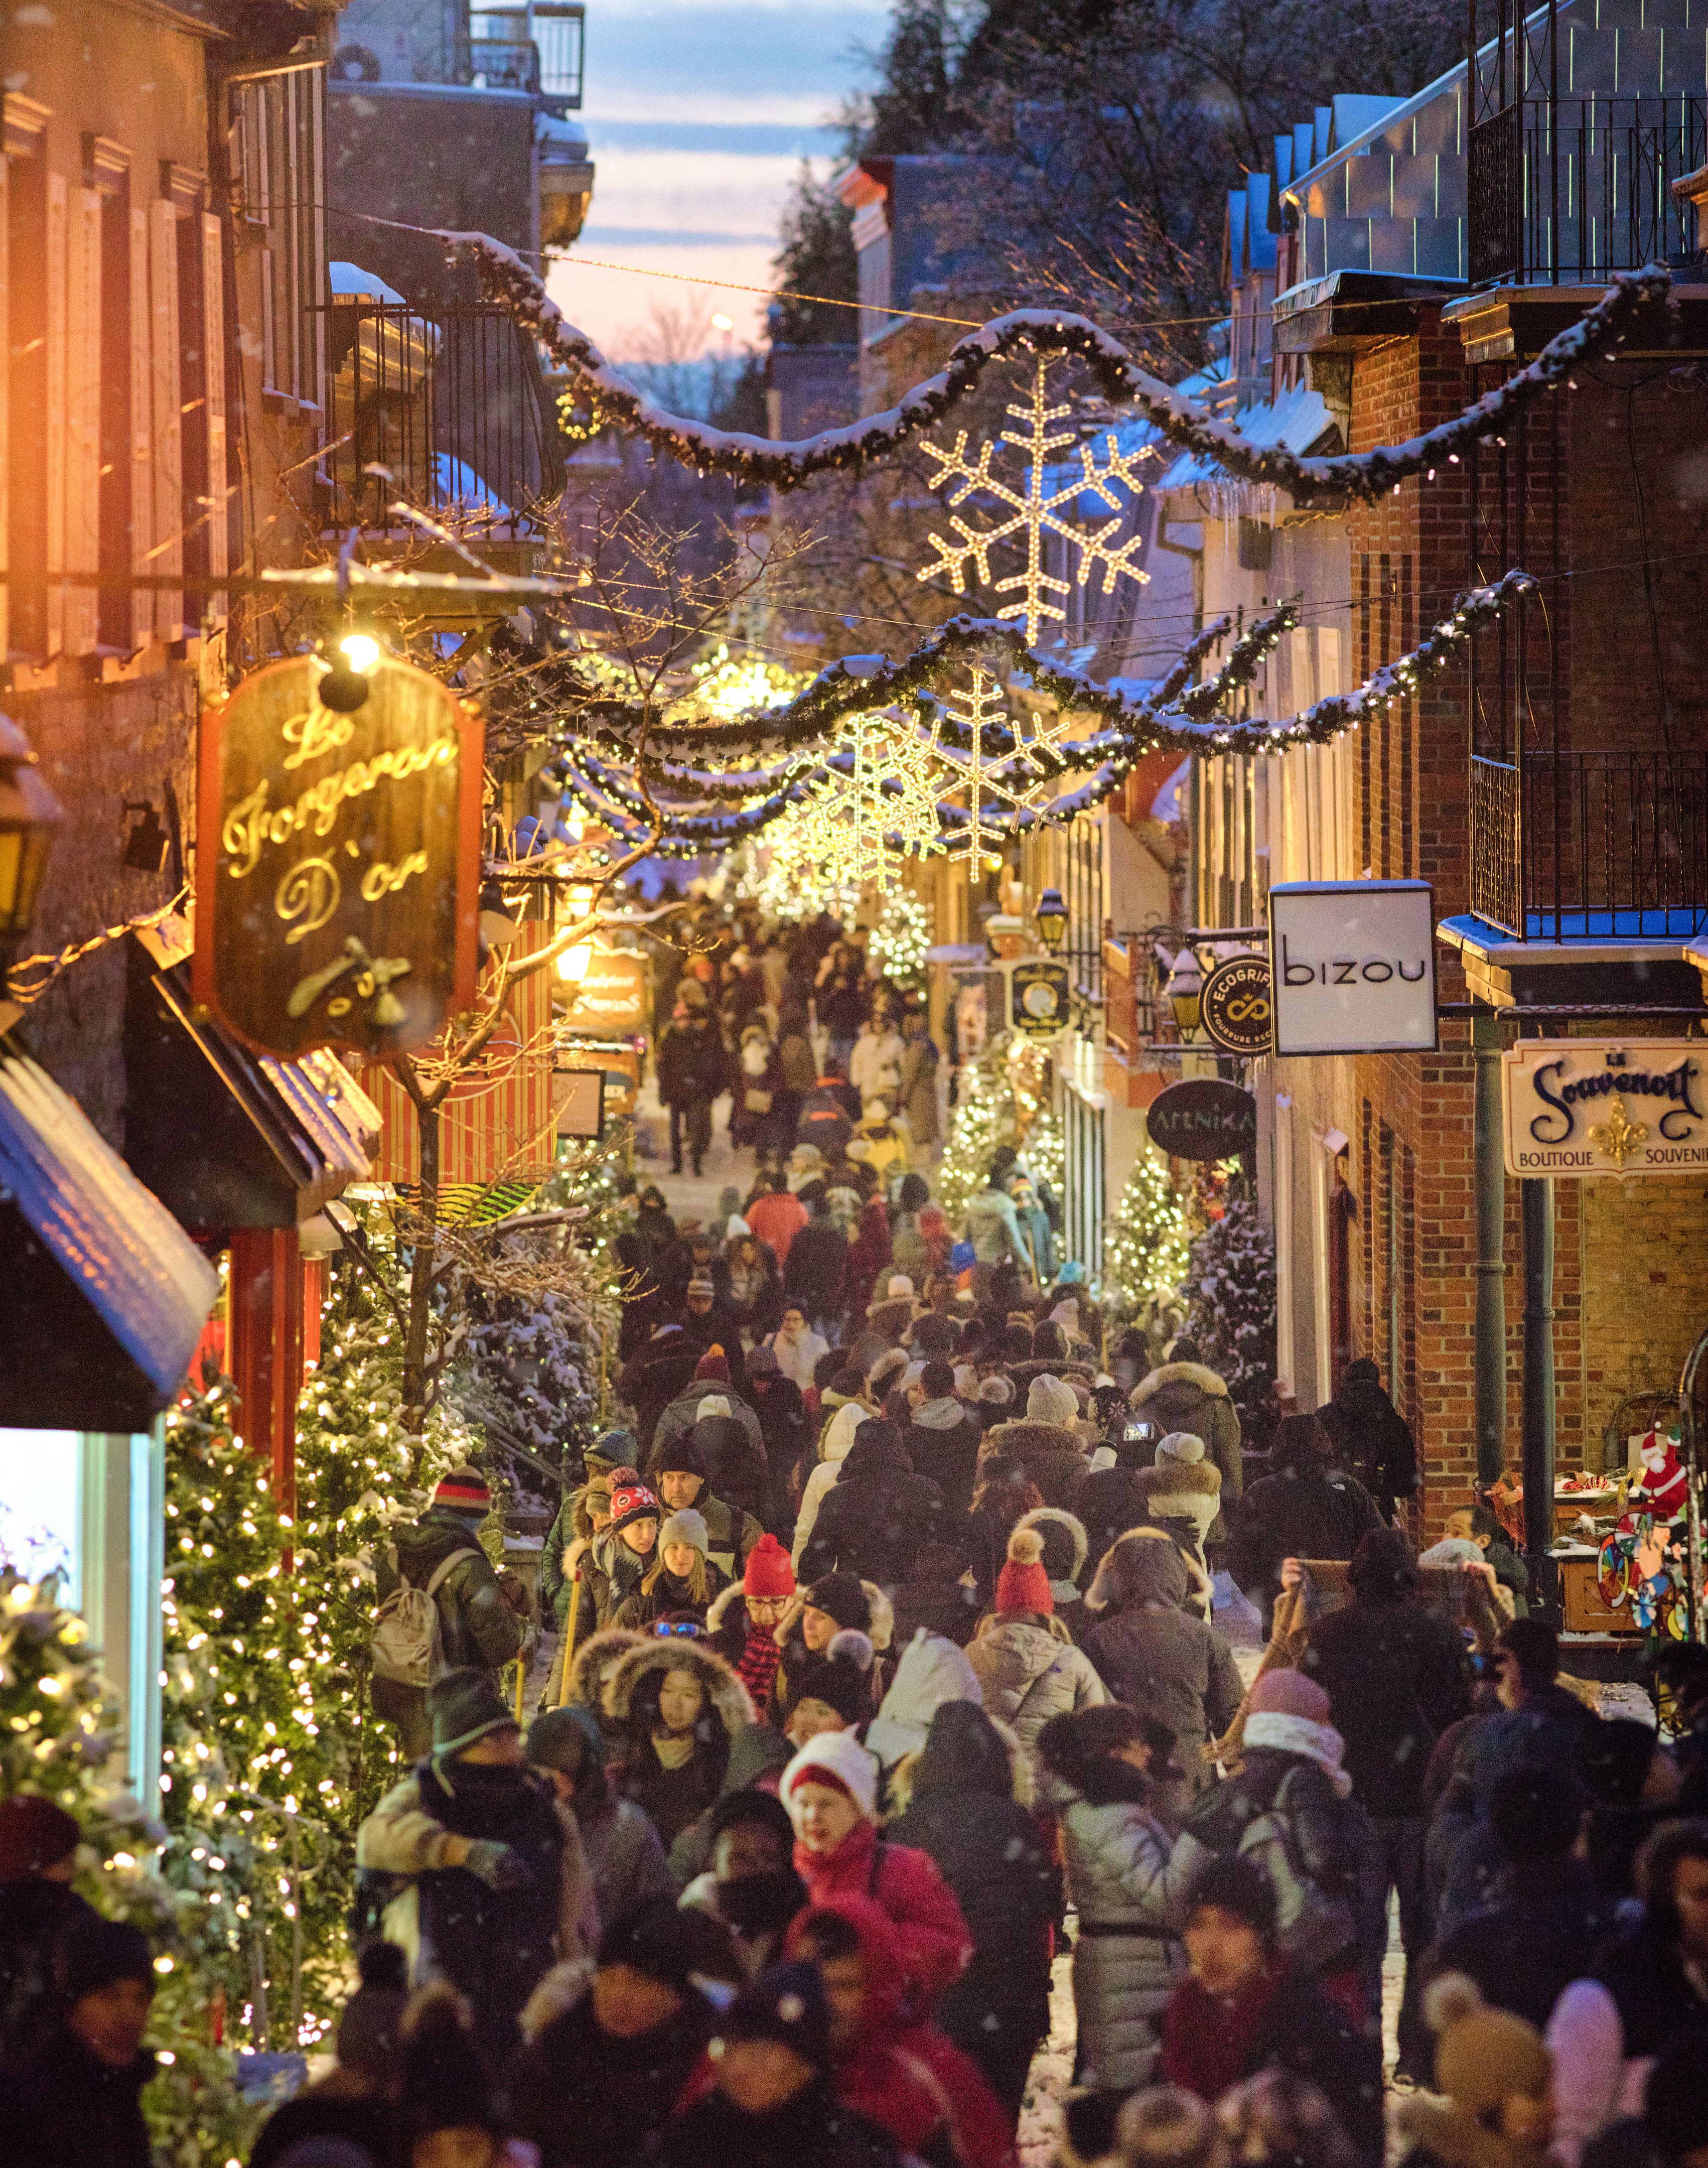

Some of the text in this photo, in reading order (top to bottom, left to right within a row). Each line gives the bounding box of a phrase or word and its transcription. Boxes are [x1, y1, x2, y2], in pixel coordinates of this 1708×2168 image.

[282, 708, 355, 770] Le
[223, 738, 459, 878] Forgeron
[1213, 969, 1270, 1002] ECOGRIF
[1283, 934, 1425, 986] bizou
[1520, 1148, 1708, 1167] BOUTIQUE SOUVENI
